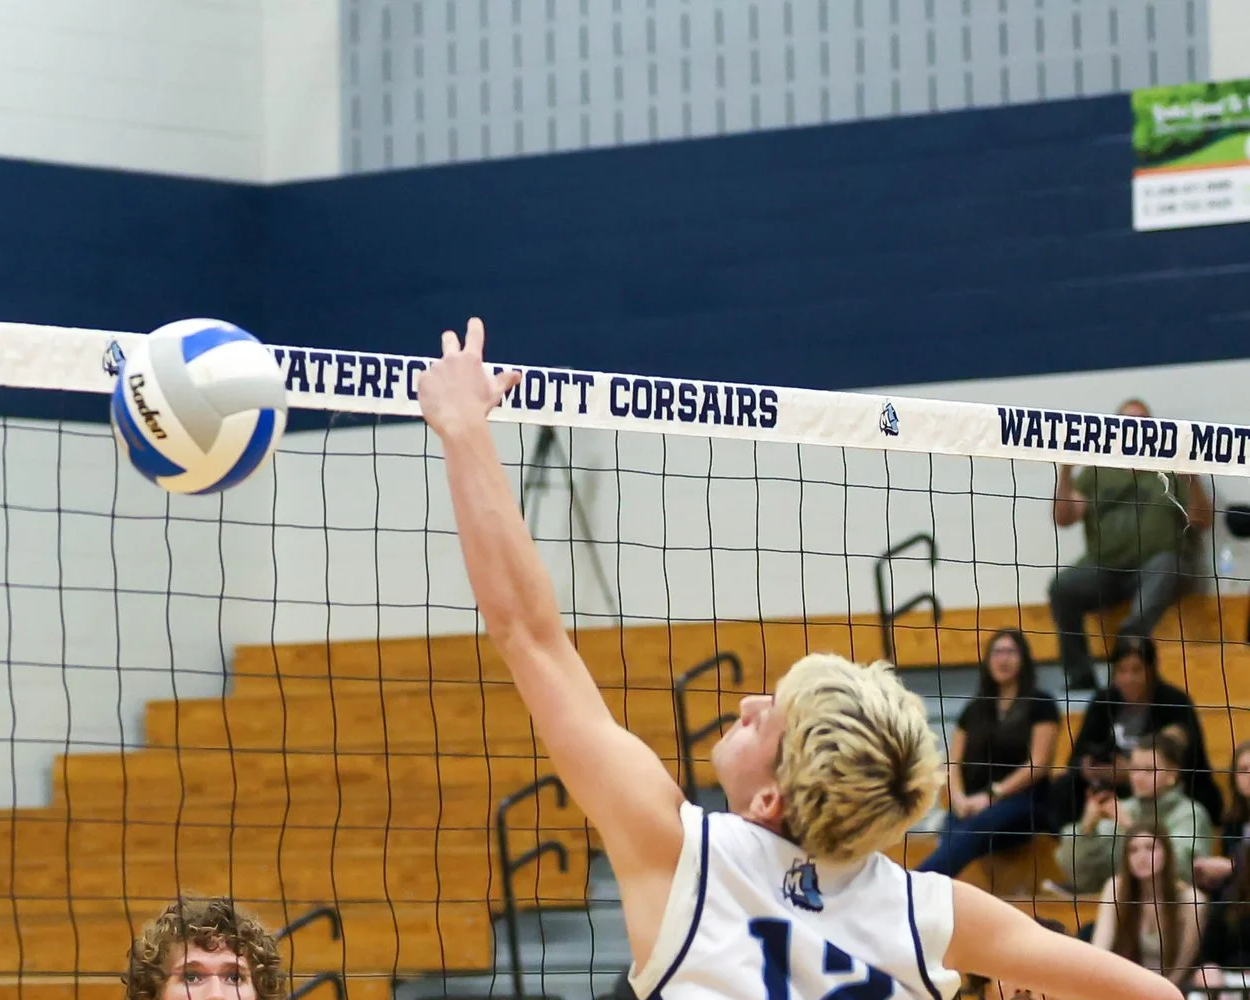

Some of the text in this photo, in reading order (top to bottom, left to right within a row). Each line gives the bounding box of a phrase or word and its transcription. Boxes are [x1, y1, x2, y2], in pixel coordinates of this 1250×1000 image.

[128, 374, 168, 440] Baden
[610, 376, 779, 429] CORSAIRS
[998, 407, 1178, 459] WATERFORD
